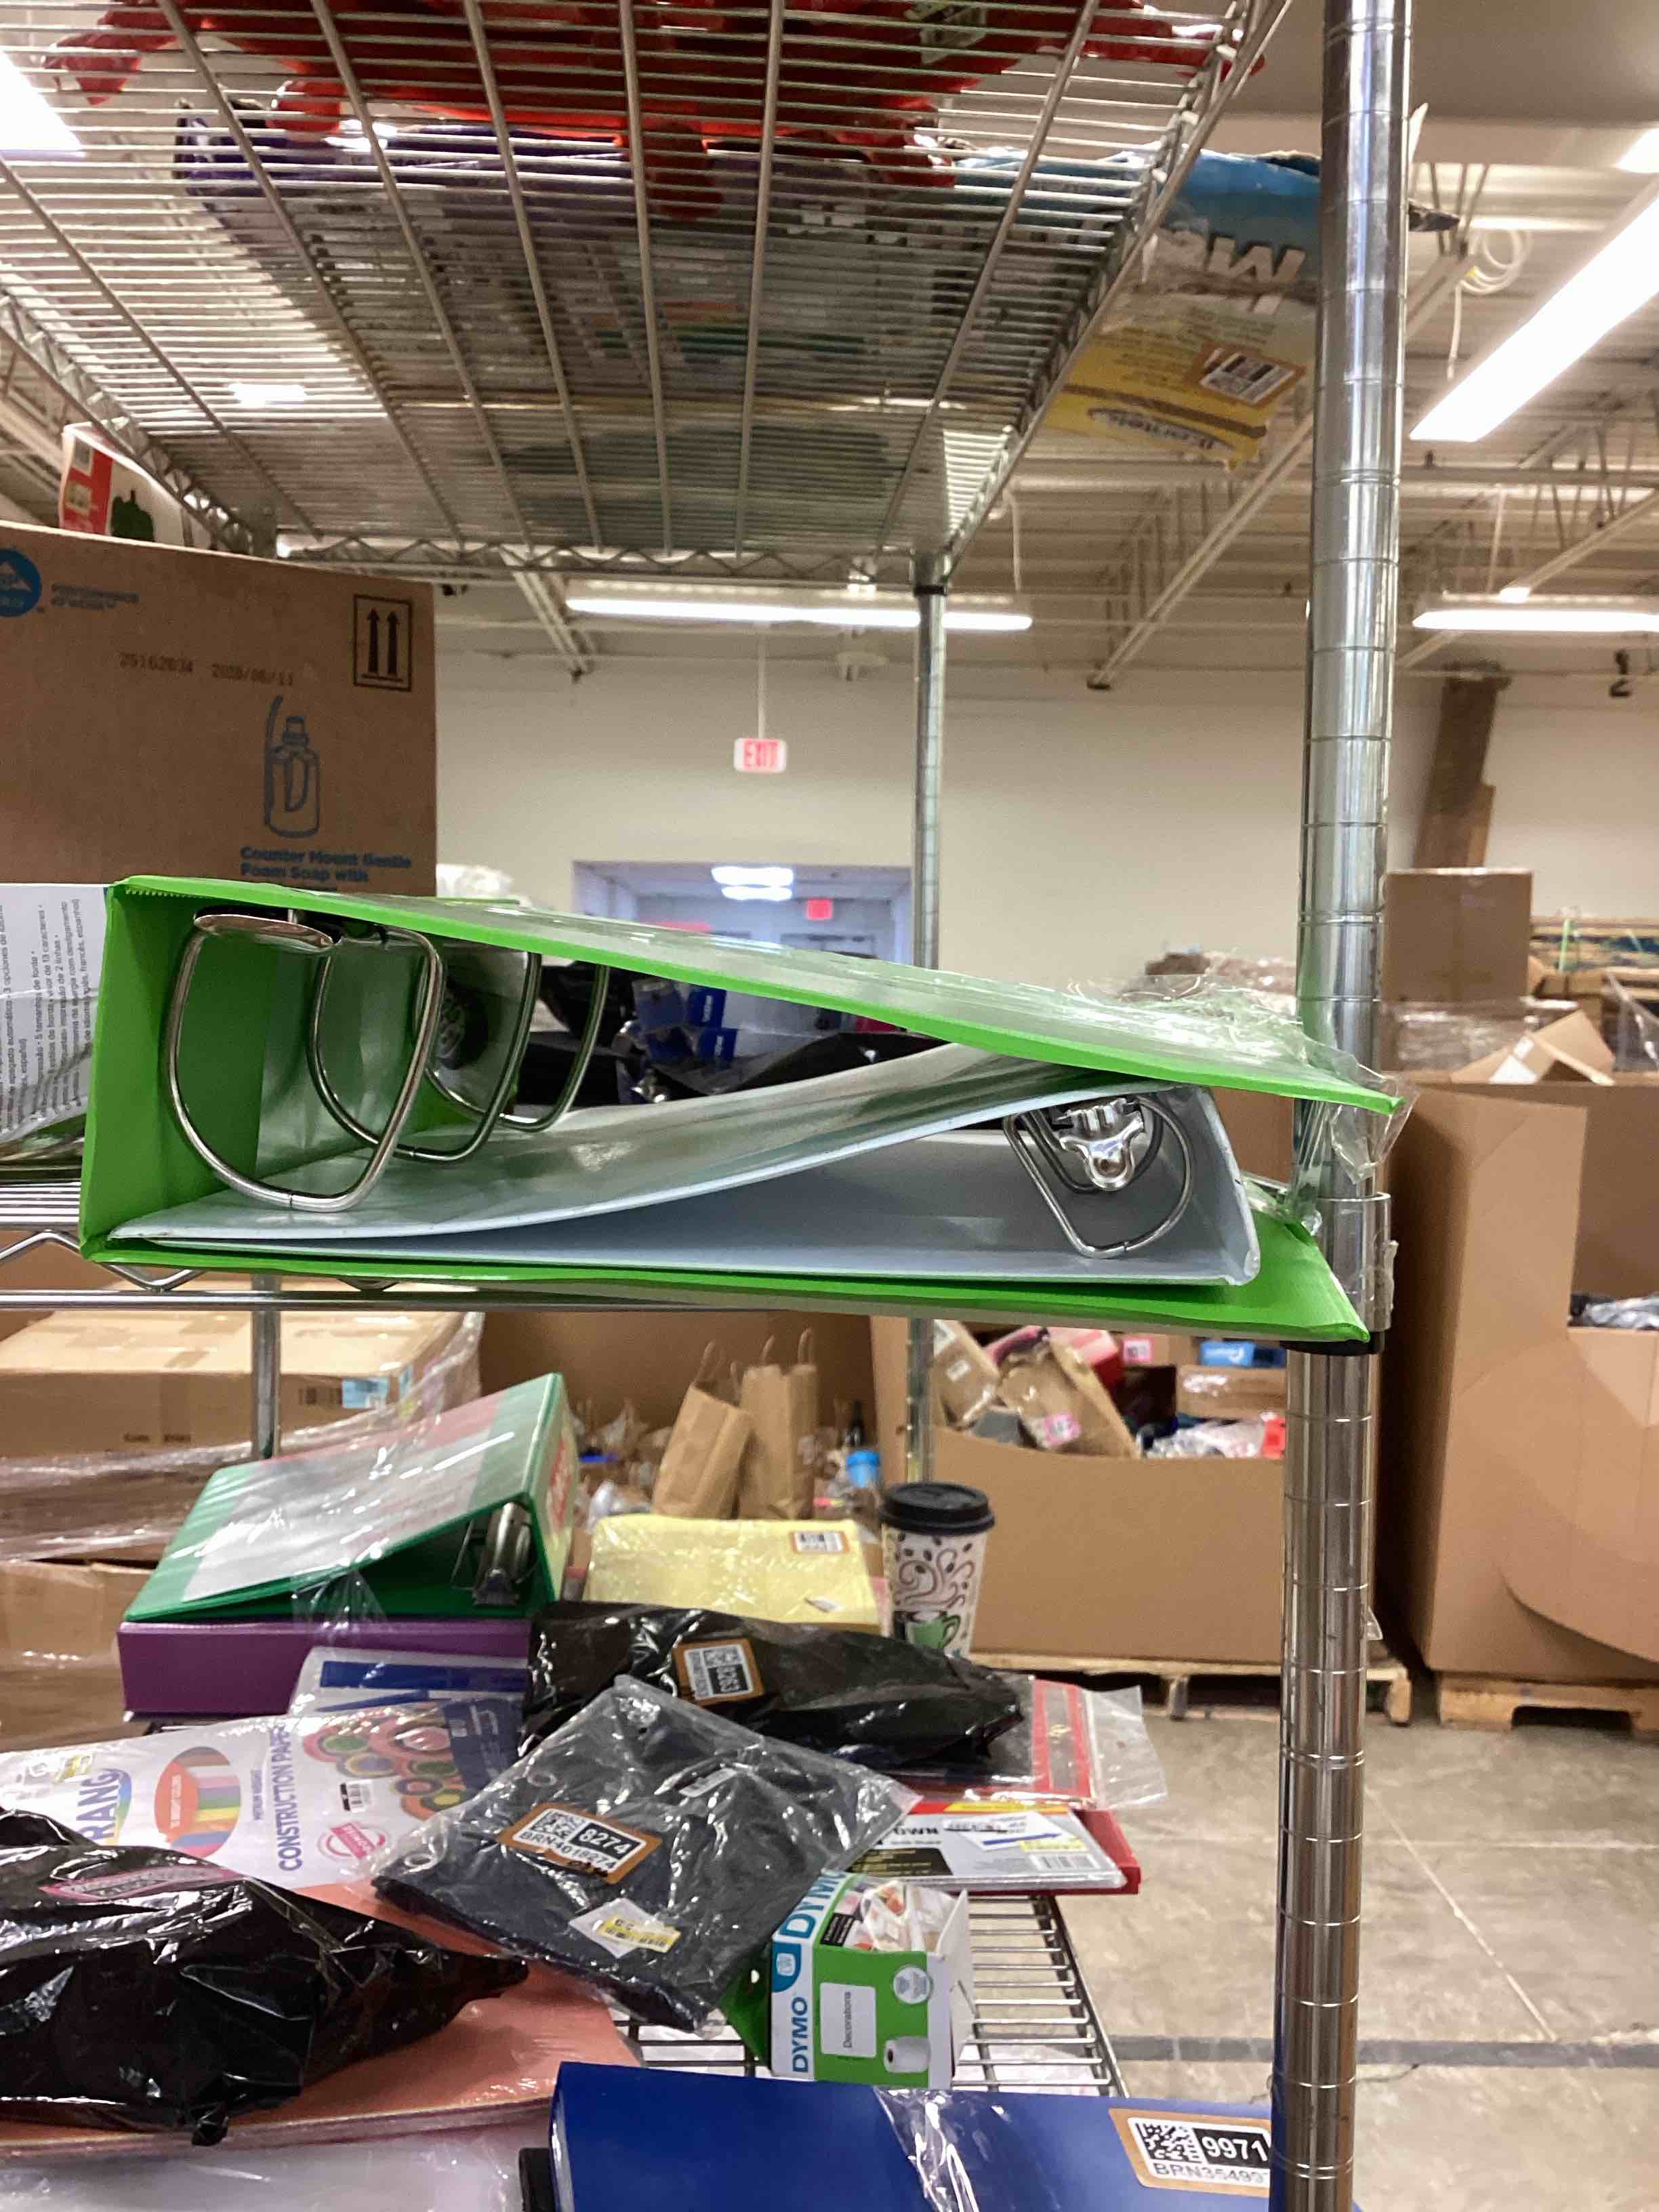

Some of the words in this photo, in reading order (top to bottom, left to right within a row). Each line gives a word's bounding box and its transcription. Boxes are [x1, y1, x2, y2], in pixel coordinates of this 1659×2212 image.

[743, 740, 779, 769] EXIT
[240, 845, 305, 863] Counter
[240, 862, 286, 877] Foam
[291, 866, 331, 881] Soap
[43, 965, 51, 975] de
[75, 1769, 122, 1841] RANG
[270, 1763, 303, 1872] CONSTRUCTION
[579, 1828, 632, 1856] 8274
[842, 1991, 853, 2049] Decorations
[791, 1996, 808, 2074] DYMO
[1201, 2135, 1269, 2162] 9971
